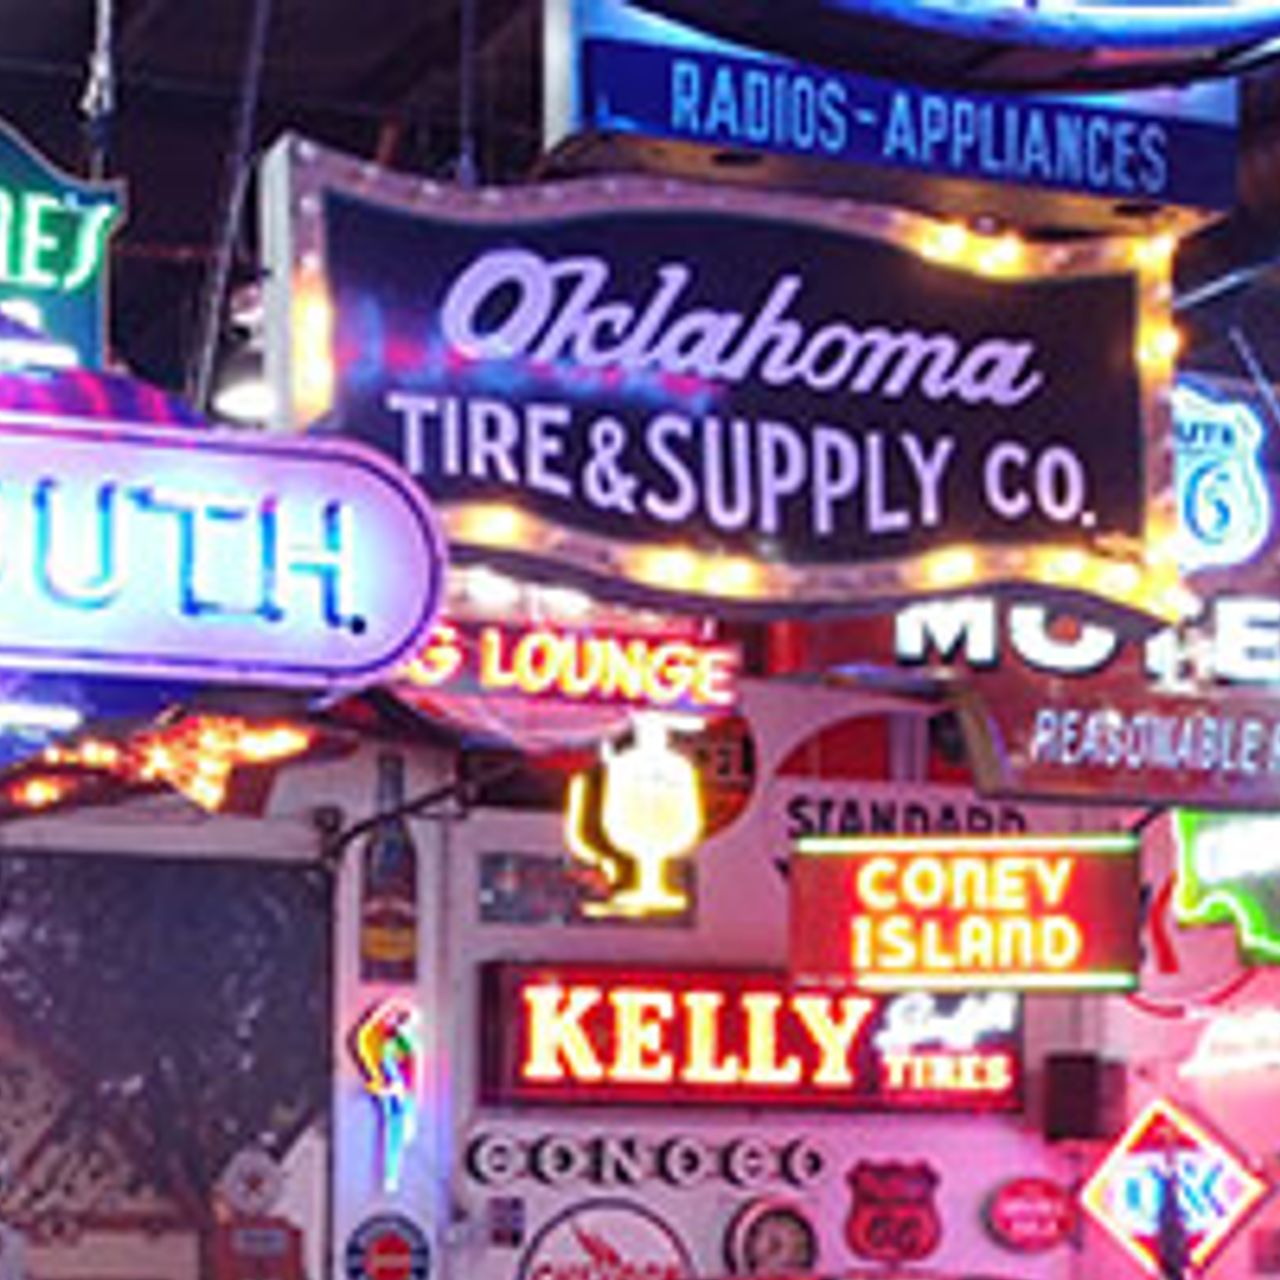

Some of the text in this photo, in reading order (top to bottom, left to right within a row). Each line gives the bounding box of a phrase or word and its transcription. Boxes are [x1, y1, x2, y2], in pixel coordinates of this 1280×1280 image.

[439, 249, 1044, 405] Oklahoma
[983, 442, 1097, 528] CO.
[479, 627, 740, 706] LOUNGE
[1030, 708, 1262, 773] REASONABLE
[857, 857, 1074, 910] CONEY
[852, 915, 1083, 970] ISLAND
[522, 984, 875, 1086] KELLY
[885, 1054, 1011, 1090] TIRES
[466, 1132, 824, 1189] CONOCO
